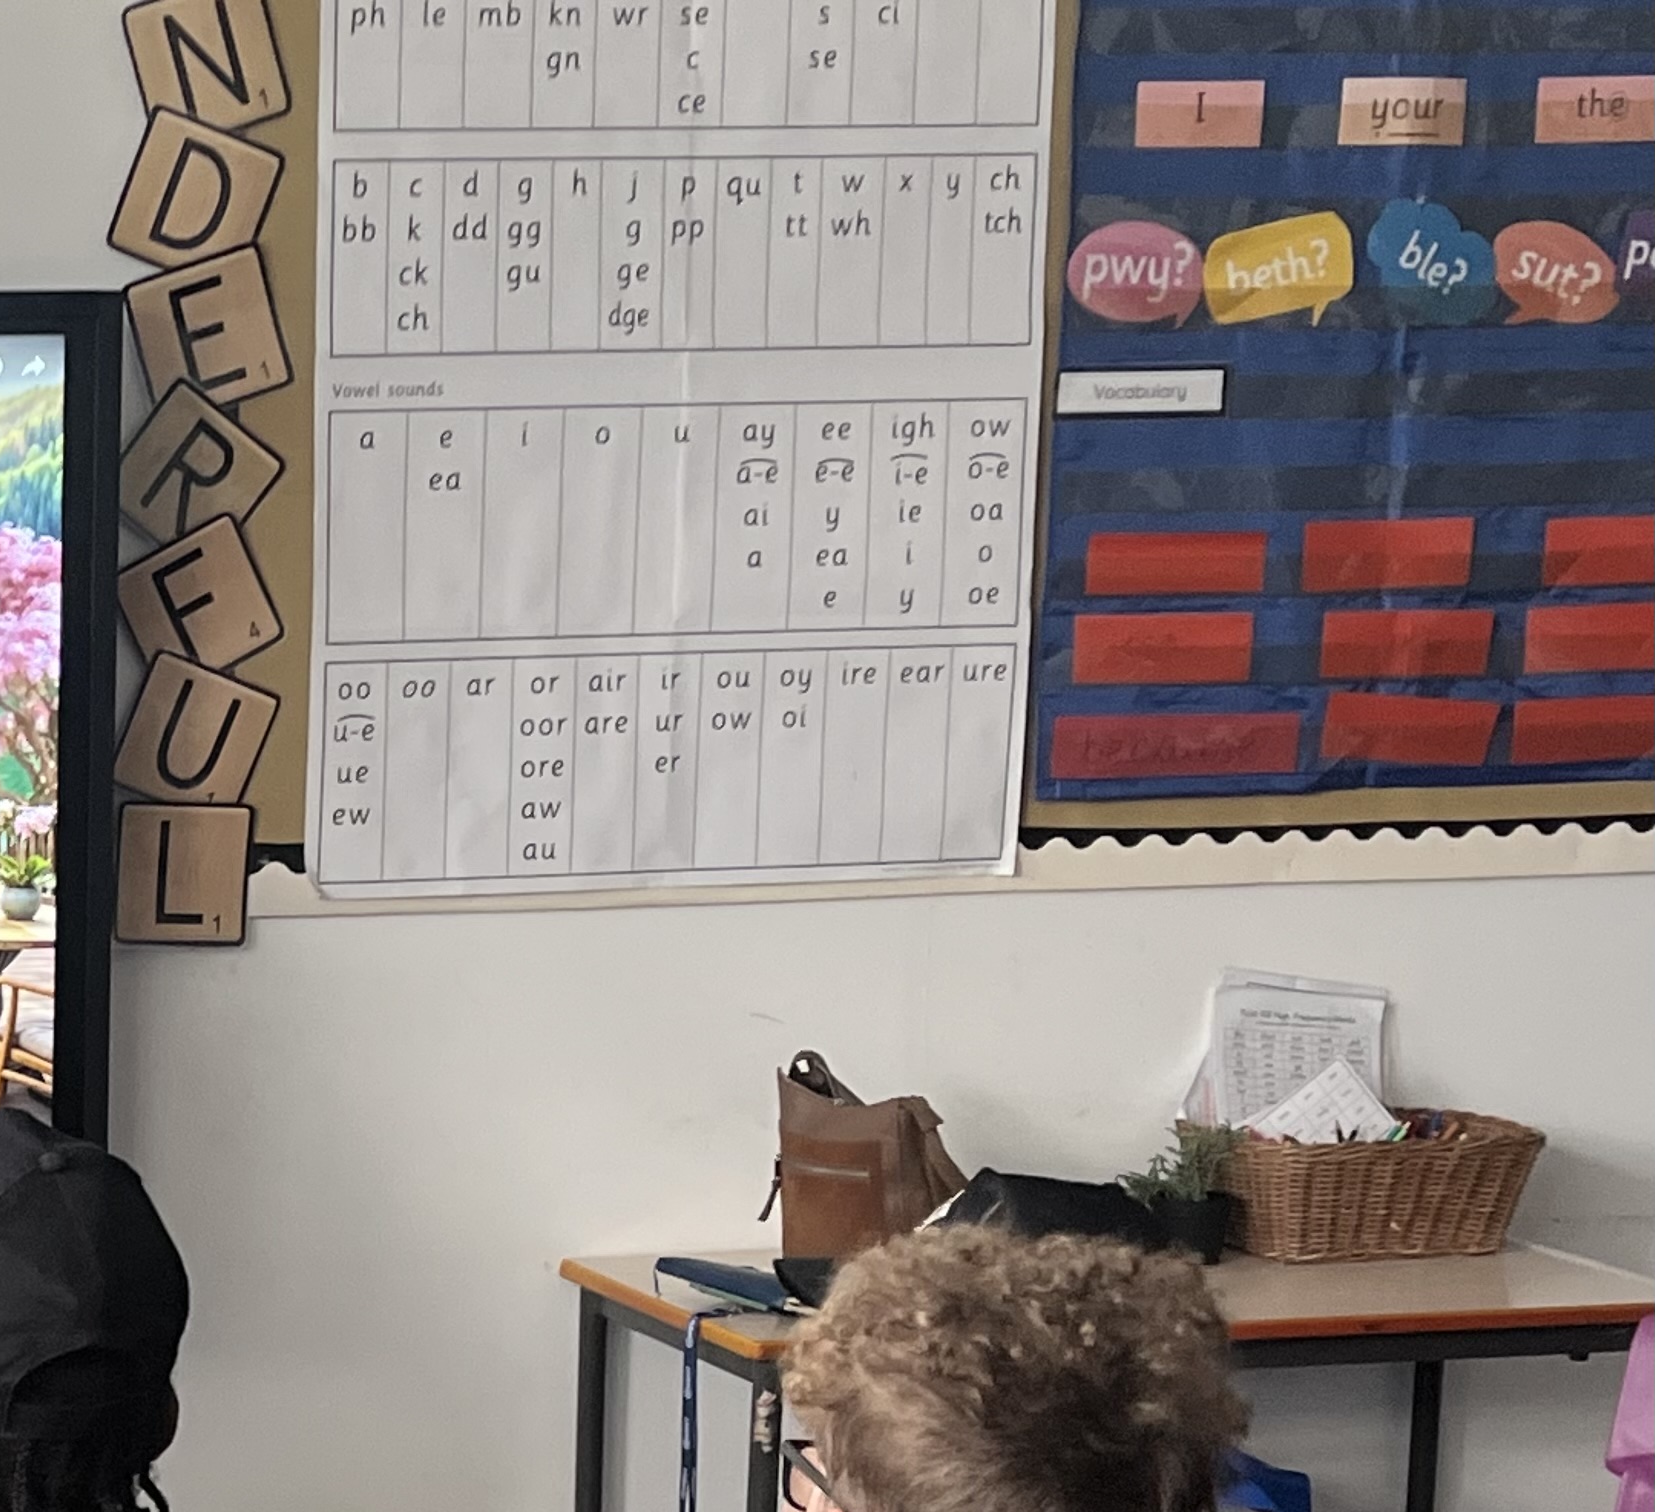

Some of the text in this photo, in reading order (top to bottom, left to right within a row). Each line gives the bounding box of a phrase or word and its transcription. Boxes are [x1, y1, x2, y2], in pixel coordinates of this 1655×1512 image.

[350, 0, 386, 36] ph
[422, 0, 446, 28] le
[478, 0, 521, 28] mb
[548, 0, 581, 27] kn
[612, 6, 649, 27] wr
[679, 5, 709, 27] se
[818, 5, 830, 25] s
[546, 49, 837, 80] gn c se
[677, 93, 706, 115] ce
[1195, 91, 1207, 123] I
[1370, 96, 1445, 129] your
[1576, 87, 1627, 119] the
[352, 163, 1021, 207] b c d g h j p qu t w x y ch
[341, 206, 1022, 249] bb k dd gg g pp tt wh tch
[398, 256, 650, 293] ck gu ge
[1082, 240, 1195, 303] pwy?
[1225, 238, 1329, 290] beth?
[1398, 229, 1468, 295] ble?
[1511, 250, 1603, 306] sut?
[396, 302, 651, 333] ch dge
[331, 380, 445, 400] Vowel sounds
[1093, 383, 1189, 403] Vocabulary
[359, 411, 1012, 450] a e i o u ay ee igh ow
[428, 471, 462, 492] ea
[743, 499, 1004, 533] ai y ie oa
[746, 540, 993, 569] a ea i o
[823, 586, 1000, 615] e y oe
[248, 620, 261, 640] 4
[337, 663, 1008, 701] oo oo ar or air ir ou oy ire ear ure
[519, 717, 568, 737] oor
[583, 715, 629, 735] are
[655, 713, 684, 733] ur
[711, 711, 753, 731] ow
[781, 709, 807, 729] oi
[336, 754, 681, 785] ue ore er
[332, 800, 562, 826] ew aw
[522, 842, 557, 861] au
[211, 913, 221, 936] 1
